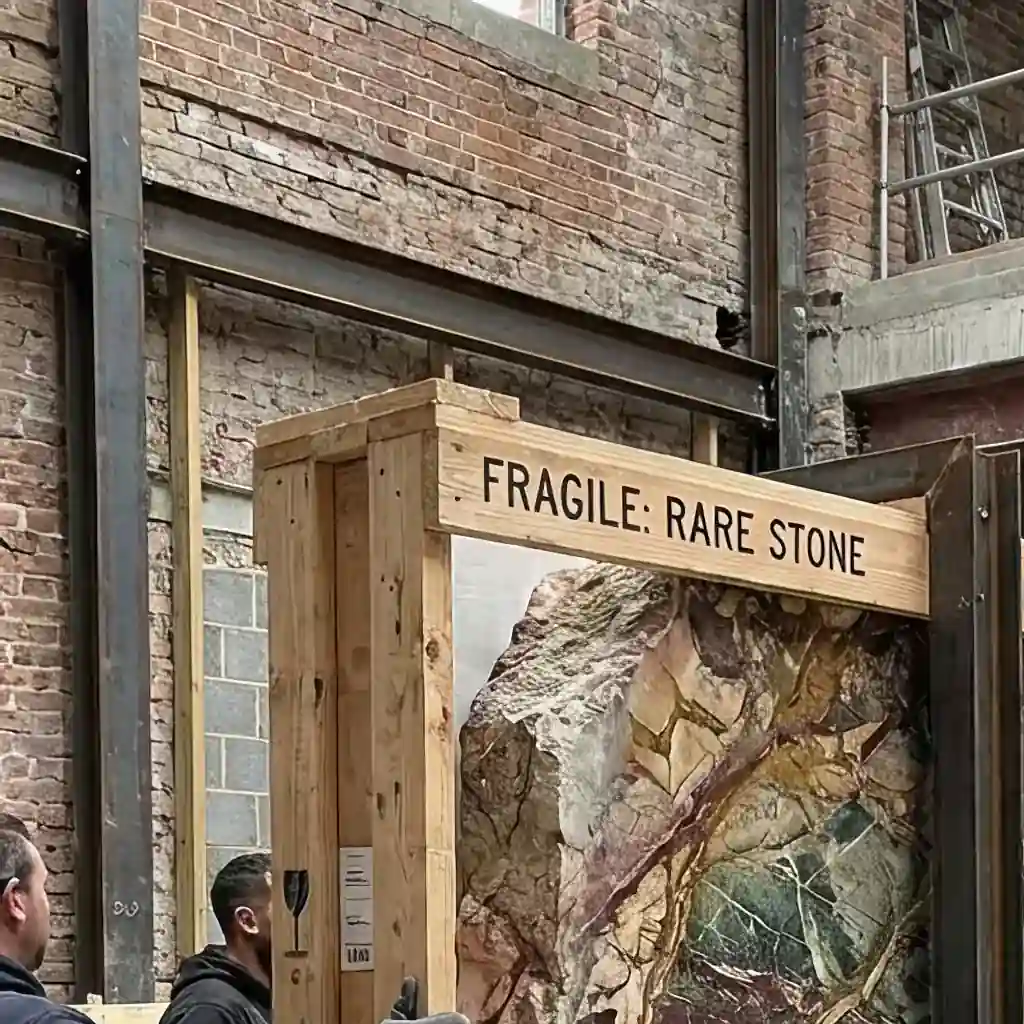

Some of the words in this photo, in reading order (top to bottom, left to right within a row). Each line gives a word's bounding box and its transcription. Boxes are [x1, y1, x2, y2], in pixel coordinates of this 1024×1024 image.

[482, 456, 651, 534] FRAGILE:
[666, 495, 755, 555] RARE
[769, 518, 867, 577] STONE
